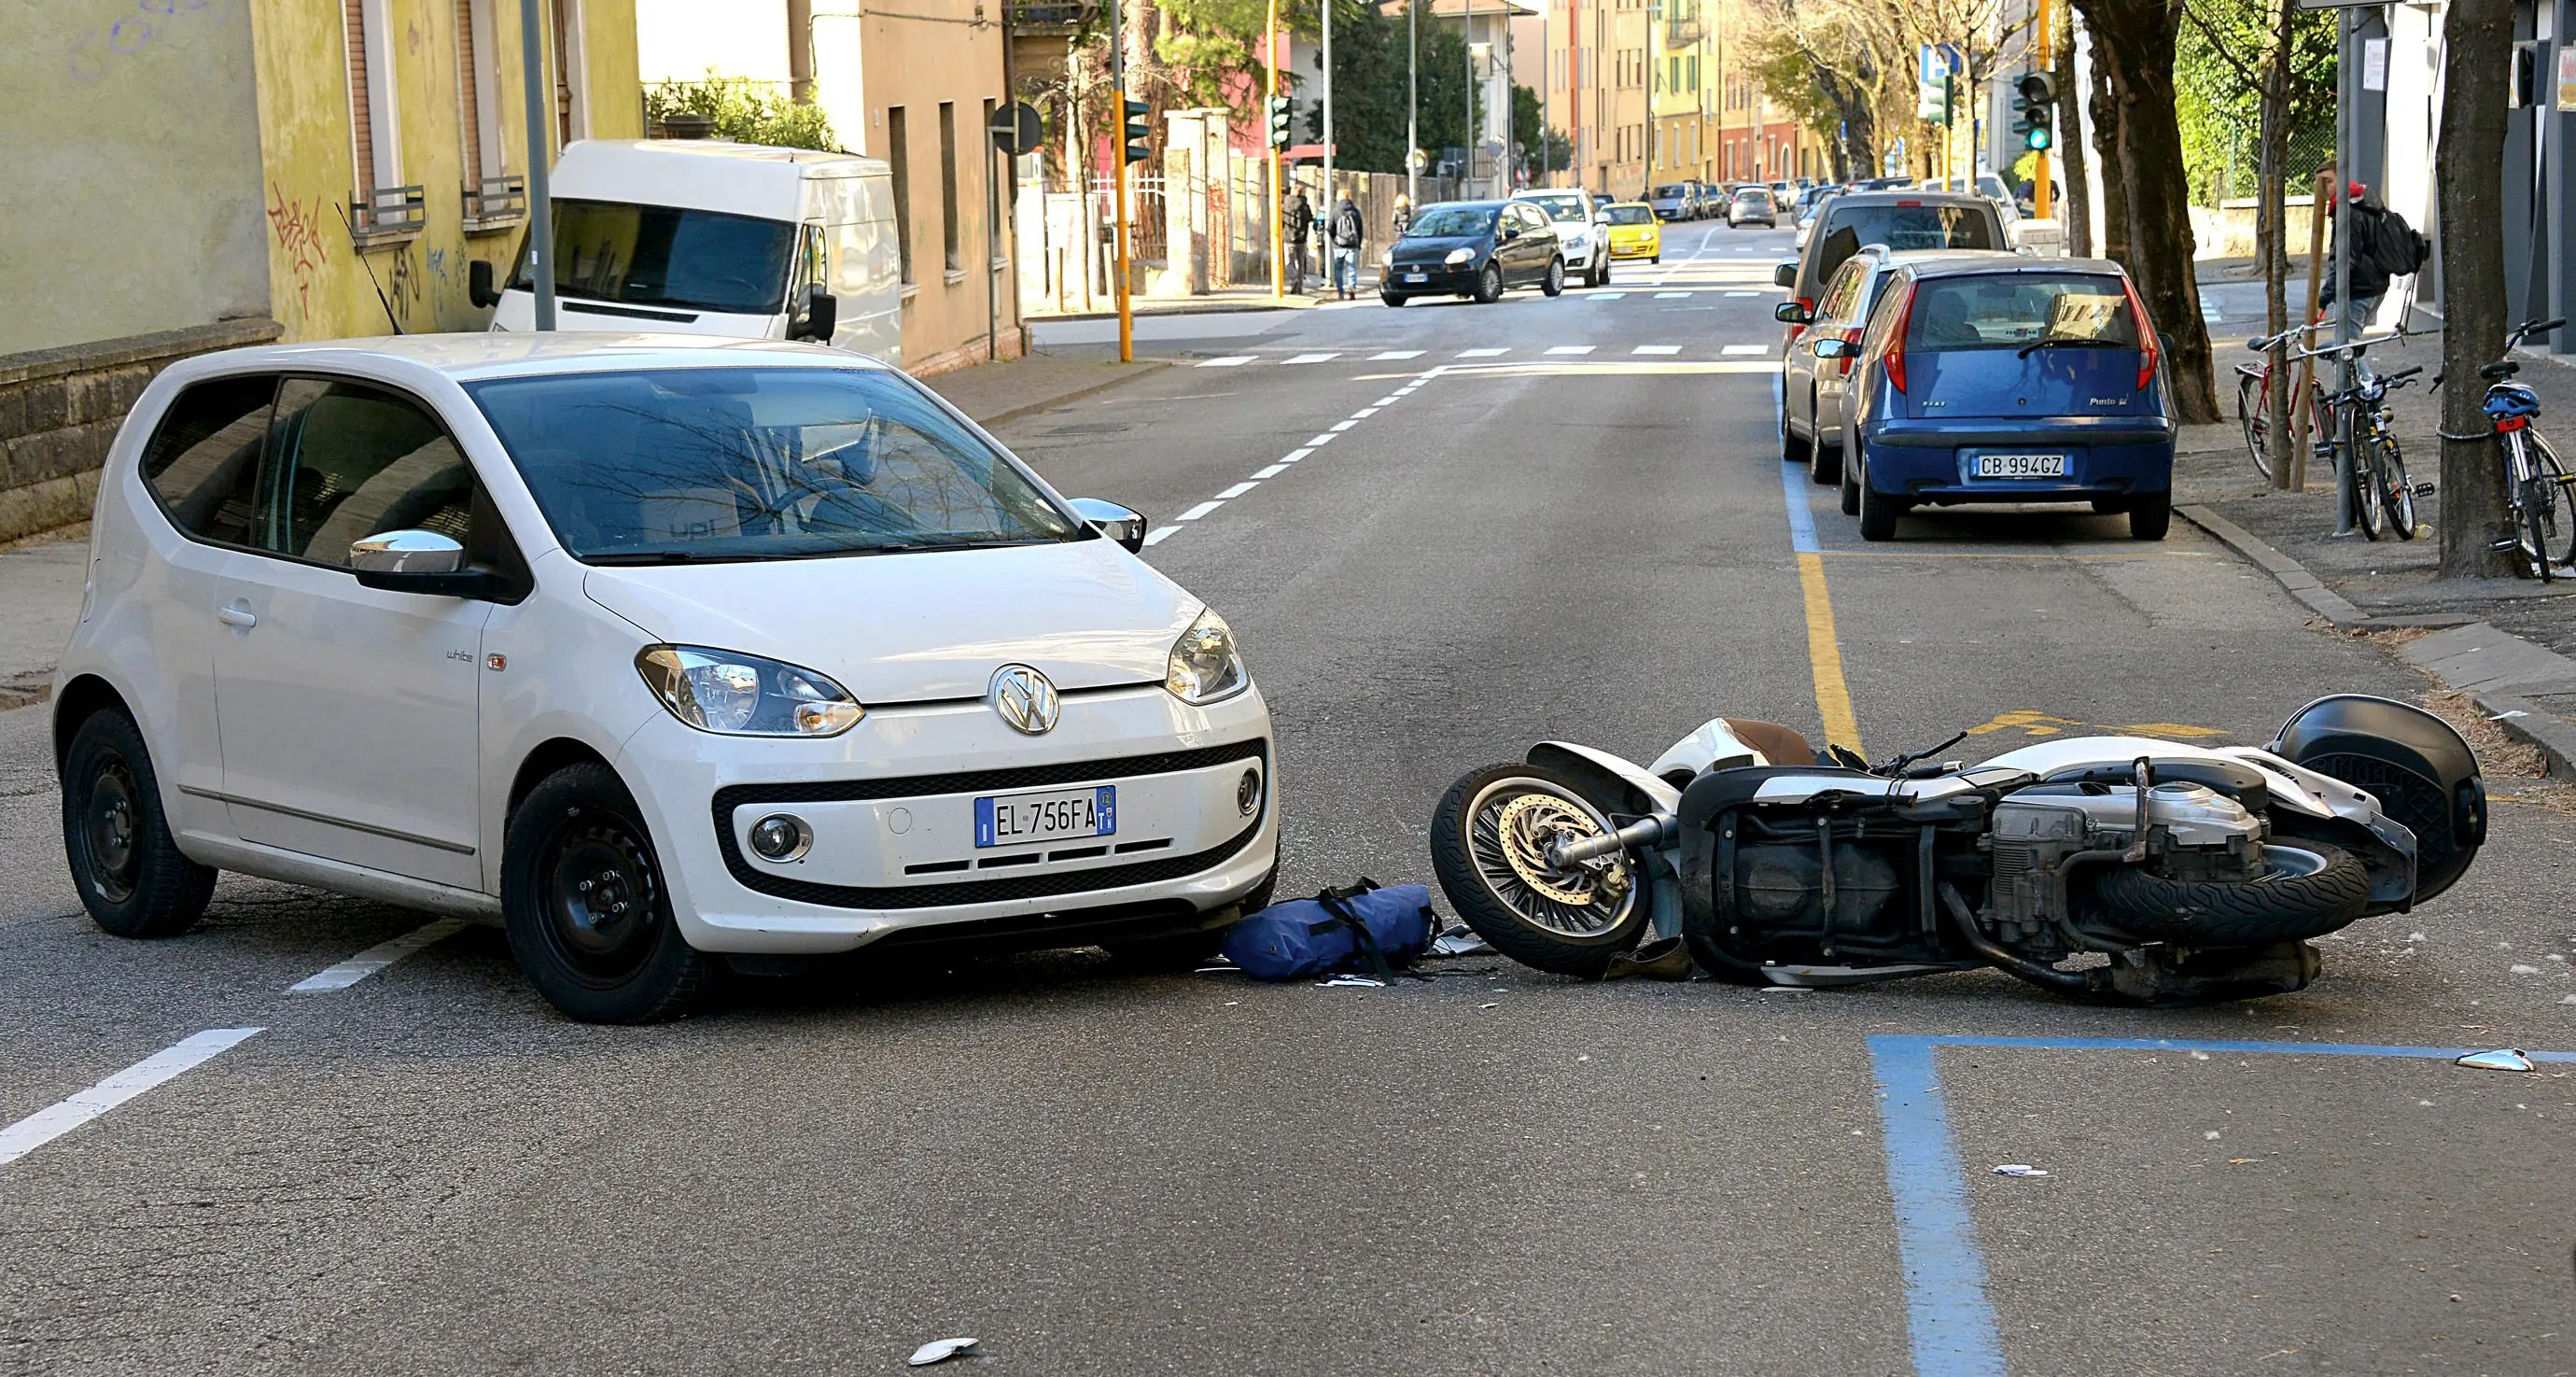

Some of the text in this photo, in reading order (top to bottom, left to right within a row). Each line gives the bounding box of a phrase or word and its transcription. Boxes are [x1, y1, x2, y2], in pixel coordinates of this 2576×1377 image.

[2090, 397, 2116, 405] Punto
[1981, 457, 2062, 474] CB 994GZ
[447, 649, 473, 662] white
[997, 797, 1096, 836] EL 756FA
